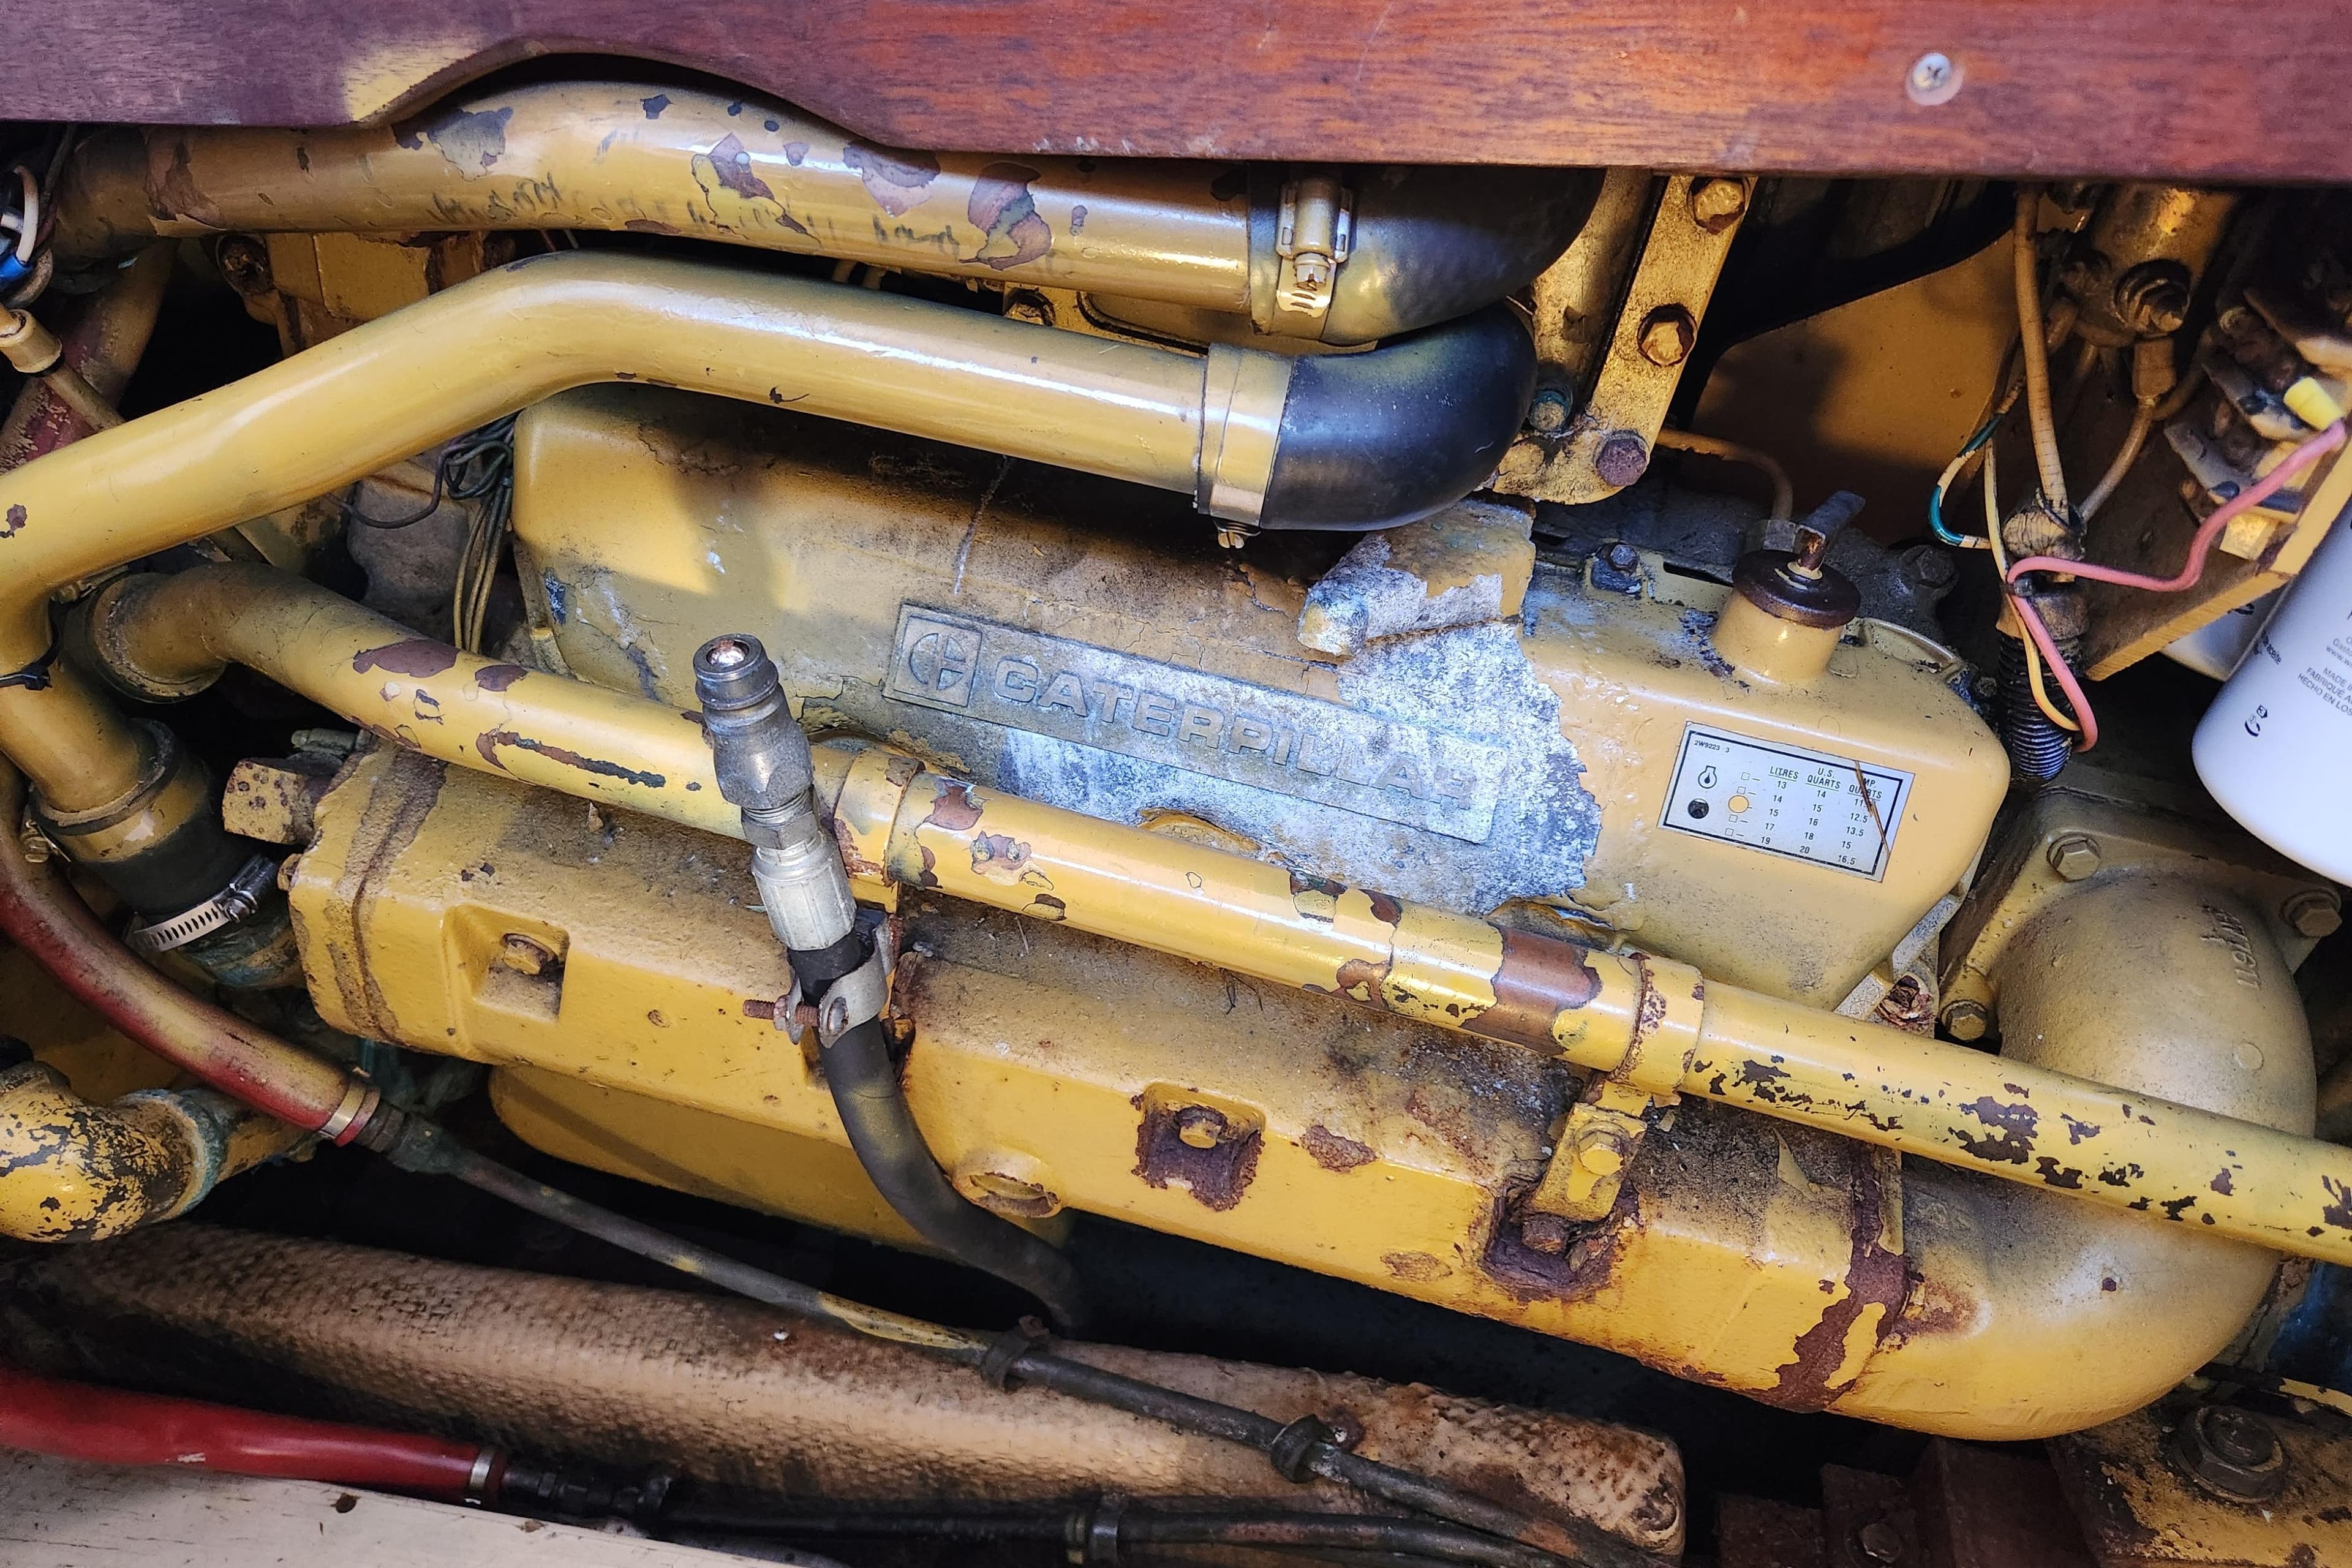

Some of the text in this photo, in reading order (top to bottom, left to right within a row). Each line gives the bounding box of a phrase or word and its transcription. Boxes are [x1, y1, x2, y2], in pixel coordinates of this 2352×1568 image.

[2306, 666, 2345, 698] FABRIQUÉ
[2322, 667, 2347, 687] MADE
[2298, 673, 2323, 696] HECHO
[2323, 692, 2335, 704] EN
[1694, 740, 1721, 751] 2W9223
[1770, 766, 1799, 780] LITRES
[1807, 774, 1842, 790] QUARTS
[1817, 767, 1835, 778] U.S.
[1777, 780, 1787, 790] 13
[1817, 790, 1826, 798] 14
[1849, 784, 1882, 799] QURTS
[1863, 777, 1877, 788] MP.
[1773, 794, 1868, 823] 14 15 12.5
[1769, 808, 1864, 837] 15 16 13.5
[1765, 822, 1852, 850] 17 18 15
[1760, 836, 1856, 865] 19 20 16.5
